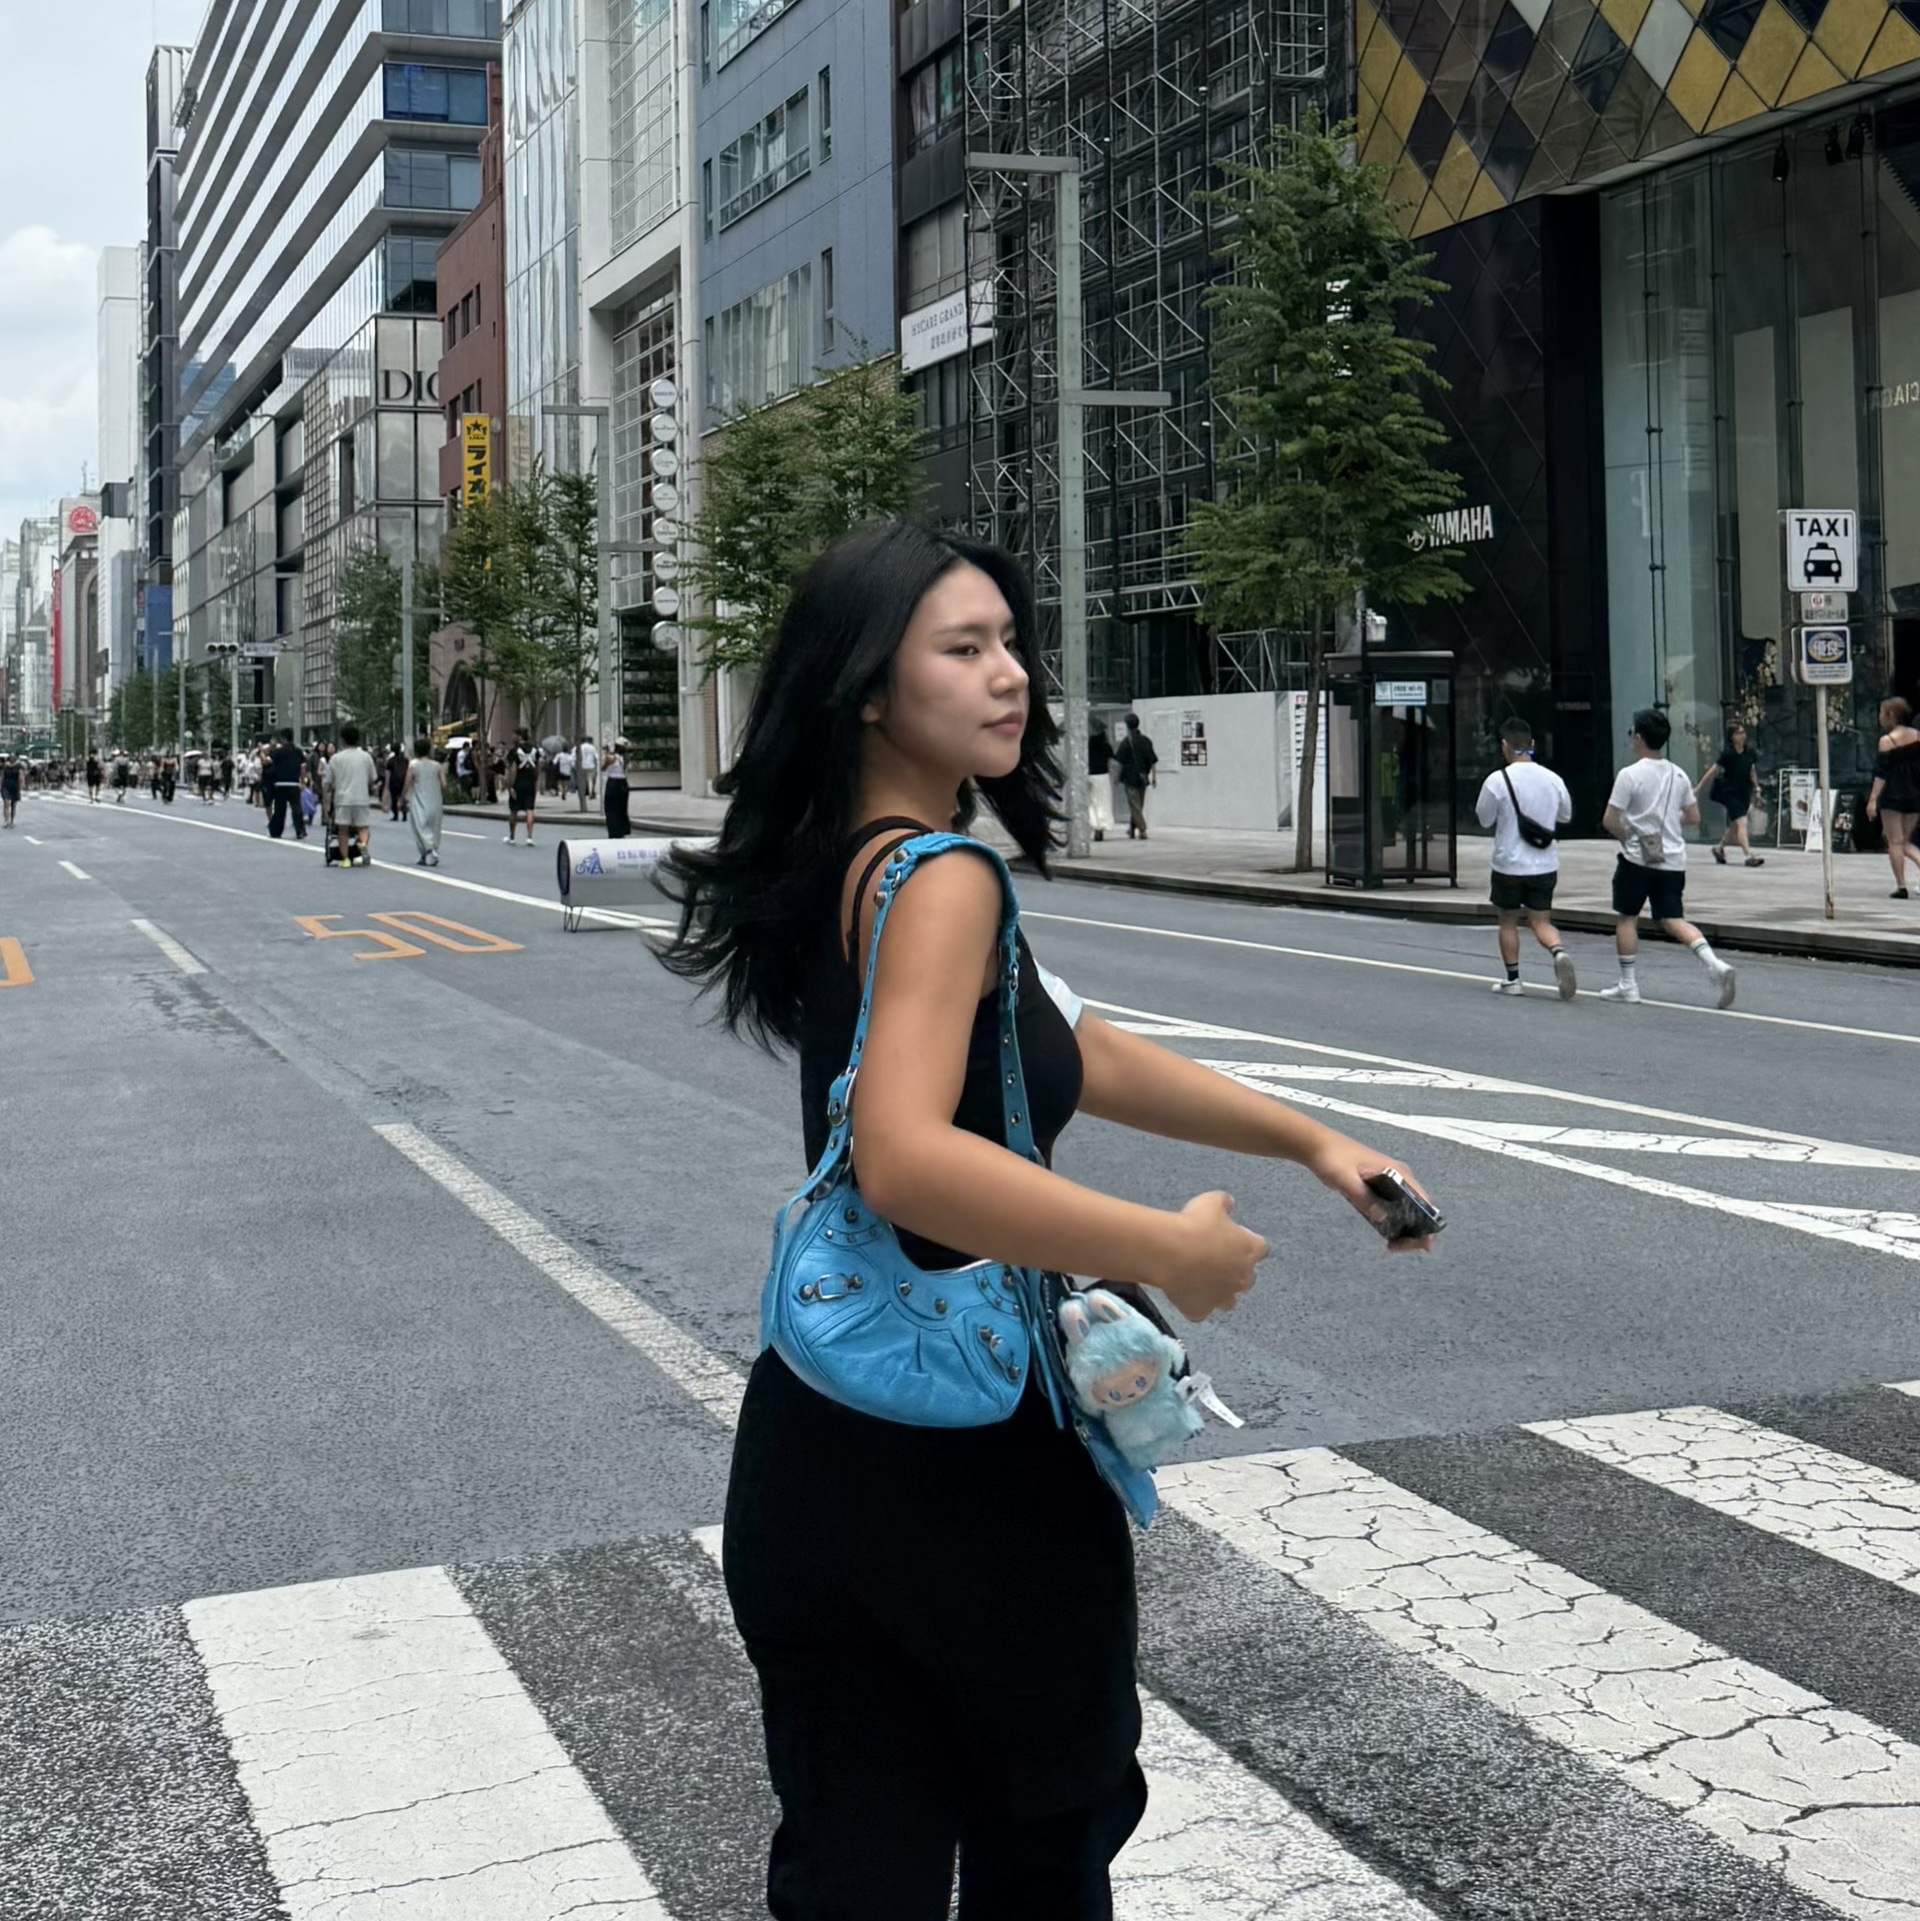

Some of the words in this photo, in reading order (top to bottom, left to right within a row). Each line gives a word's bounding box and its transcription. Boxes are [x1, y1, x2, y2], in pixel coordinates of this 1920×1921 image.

[1426, 504, 1494, 548] YAMAHA
[1795, 517, 1848, 537] TAXI
[293, 911, 526, 960] 50
